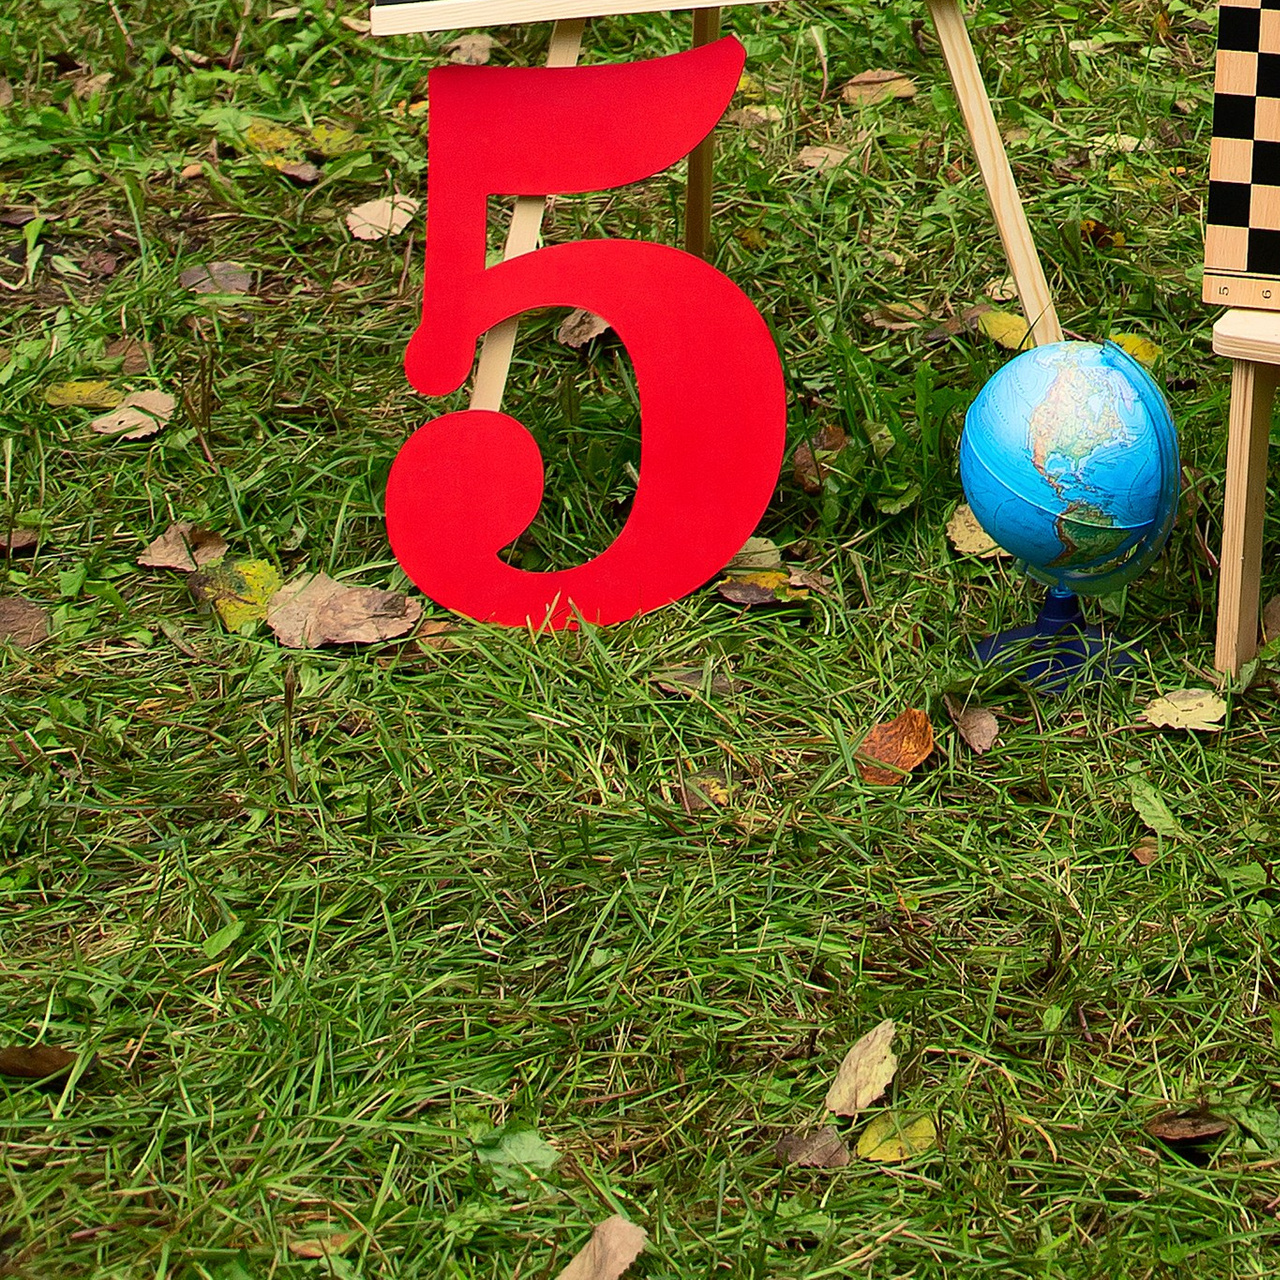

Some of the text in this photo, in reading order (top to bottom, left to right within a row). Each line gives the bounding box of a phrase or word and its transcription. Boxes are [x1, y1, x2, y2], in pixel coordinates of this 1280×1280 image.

[385, 35, 787, 632] 5
[1218, 286, 1230, 296] 5
[1261, 289, 1272, 299] 6
